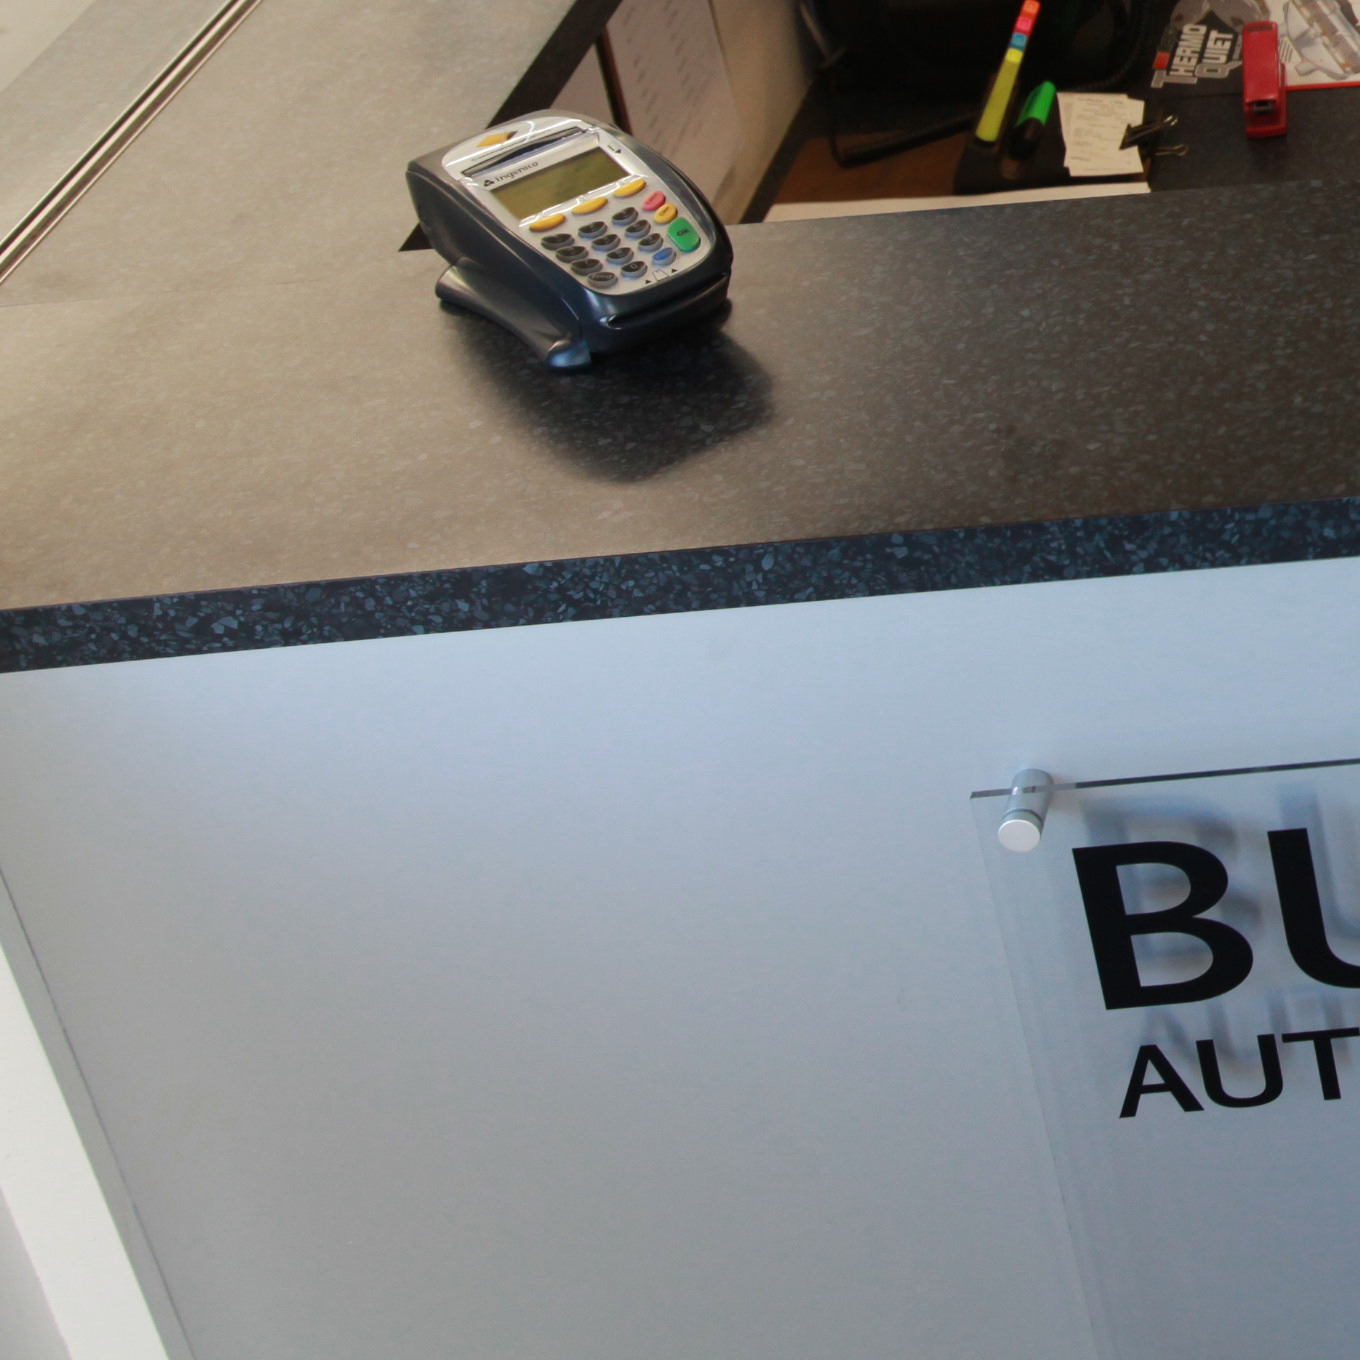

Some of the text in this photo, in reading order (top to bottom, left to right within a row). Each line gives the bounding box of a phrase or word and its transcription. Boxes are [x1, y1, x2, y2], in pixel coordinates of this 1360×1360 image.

[1151, 23, 1207, 88] THERMO
[1195, 29, 1242, 78] QUIET
[676, 228, 690, 237] OK
